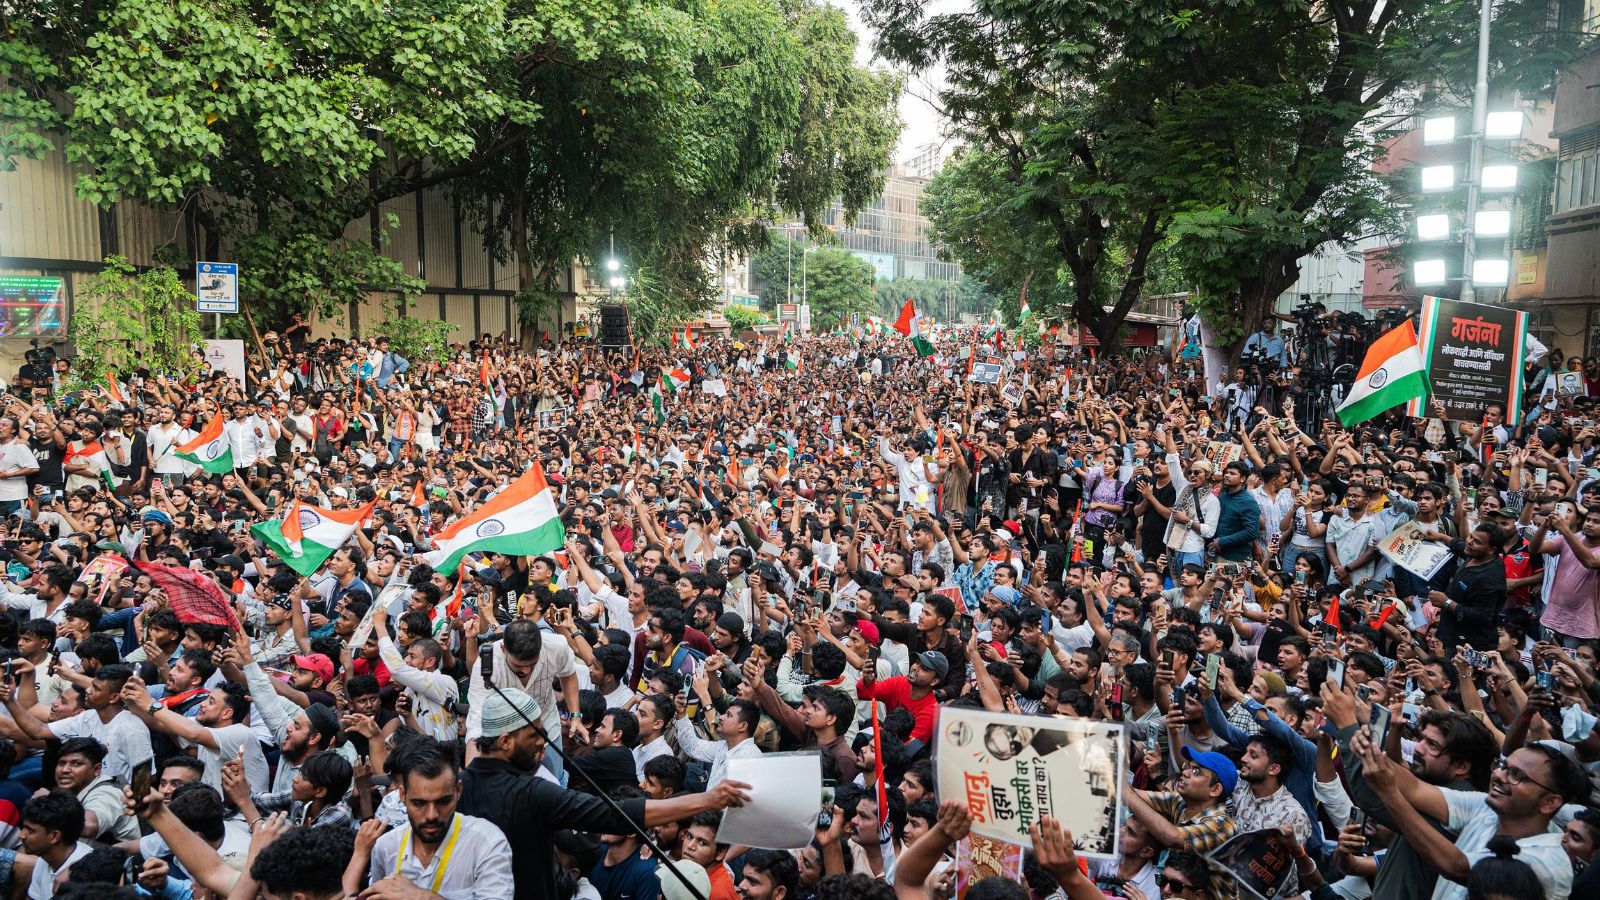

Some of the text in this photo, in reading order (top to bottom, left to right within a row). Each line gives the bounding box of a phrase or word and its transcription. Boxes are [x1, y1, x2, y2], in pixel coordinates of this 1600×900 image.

[1452, 316, 1501, 347] गर्जना
[1441, 343, 1504, 361] लोकशाही आणि संविधान
[1453, 358, 1491, 371] वाचवण्यासाठी
[1016, 759, 1029, 775] वर
[991, 784, 1014, 820] तुझा
[1036, 784, 1047, 805] नाय
[983, 839, 993, 856] 2
[970, 847, 1002, 877] Ajwain
